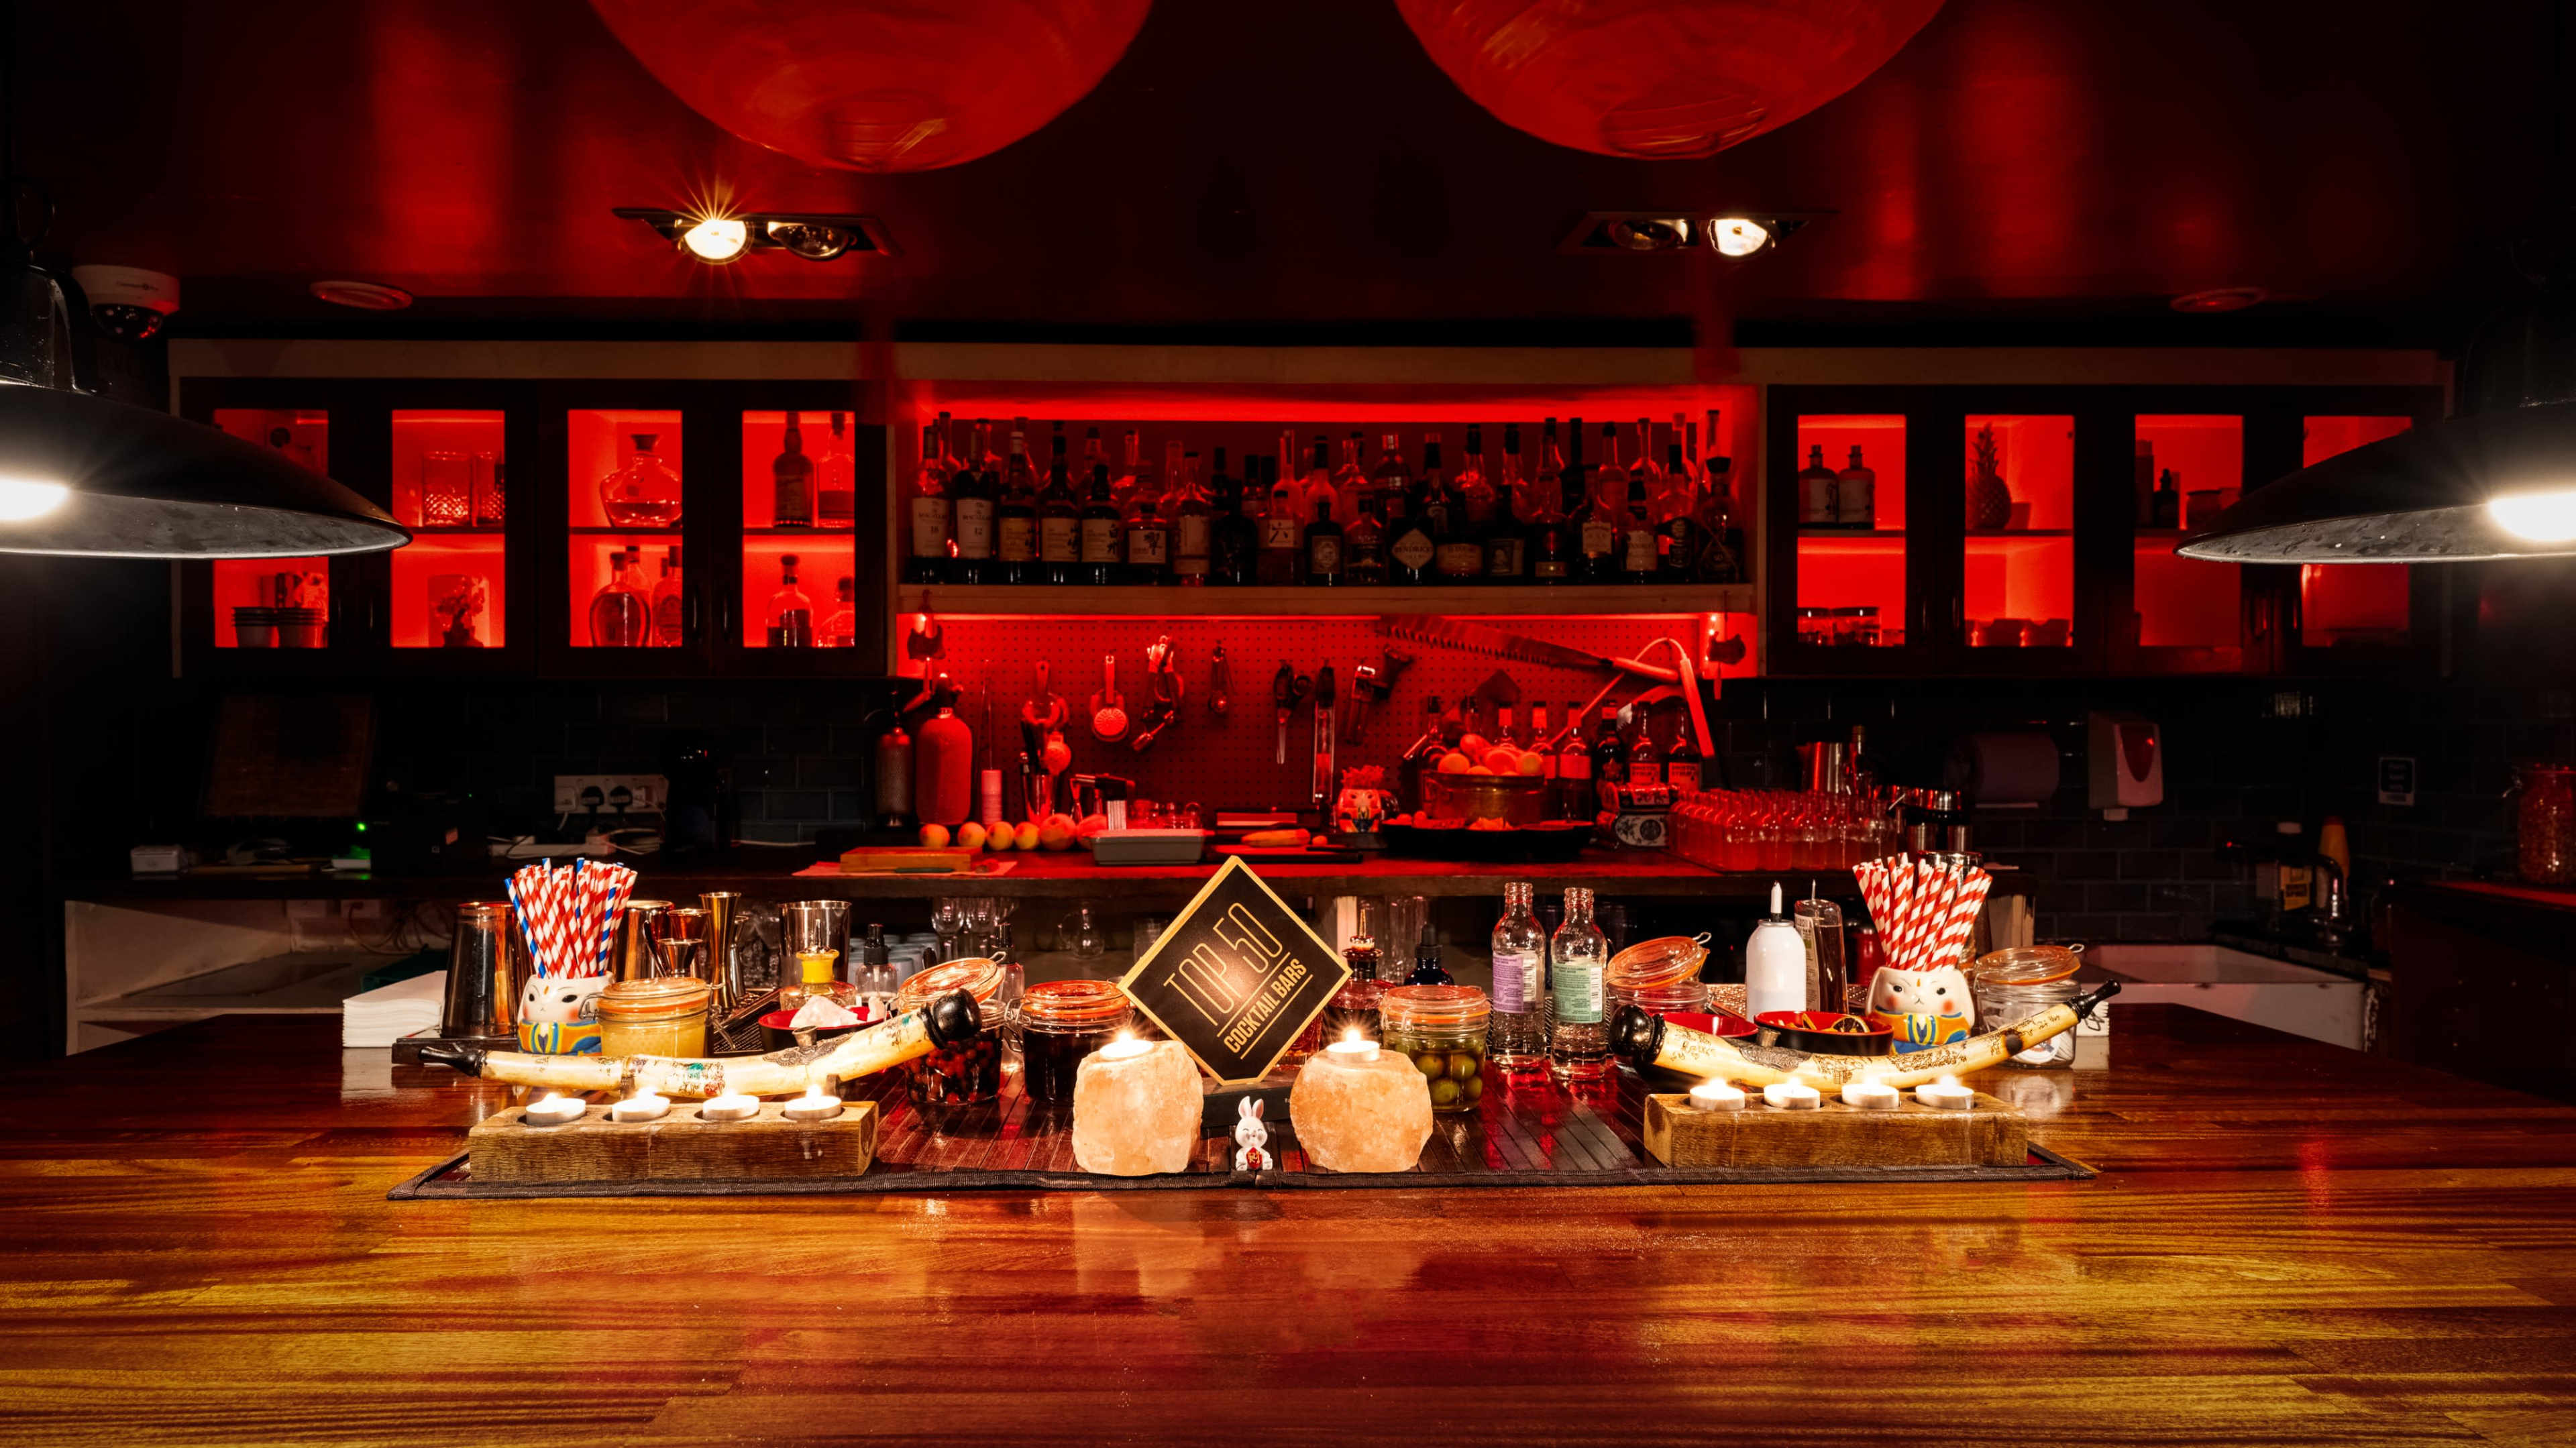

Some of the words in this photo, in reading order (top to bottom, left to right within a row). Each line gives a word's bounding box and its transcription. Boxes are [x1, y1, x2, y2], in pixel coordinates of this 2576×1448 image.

[1164, 942, 1241, 1026] TOP
[1213, 903, 1283, 974] 50
[1223, 991, 1280, 1054] COCKTAIL
[1271, 958, 1307, 999] BARS
